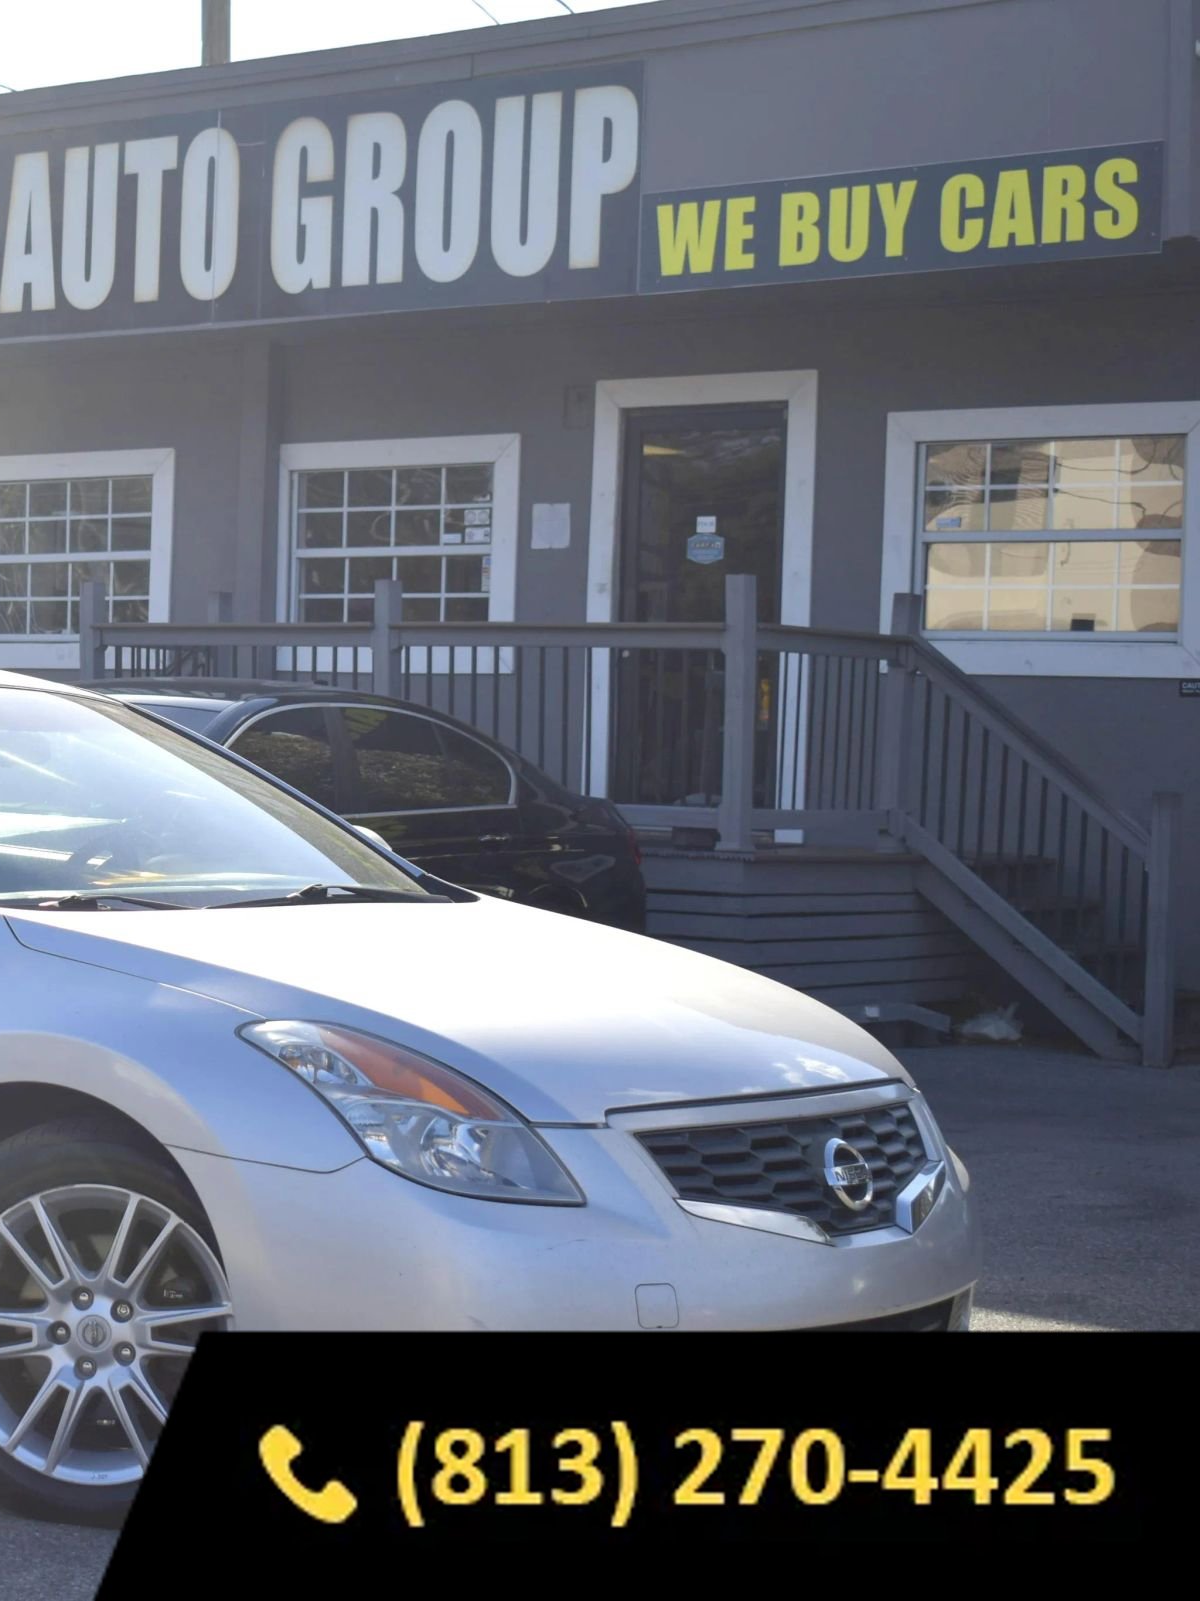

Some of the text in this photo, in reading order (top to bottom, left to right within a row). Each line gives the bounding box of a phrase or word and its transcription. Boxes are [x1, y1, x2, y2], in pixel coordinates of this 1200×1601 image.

[0, 128, 240, 313] AUTO
[270, 86, 638, 293] GROUP
[658, 158, 1138, 276] WE BUY CARS
